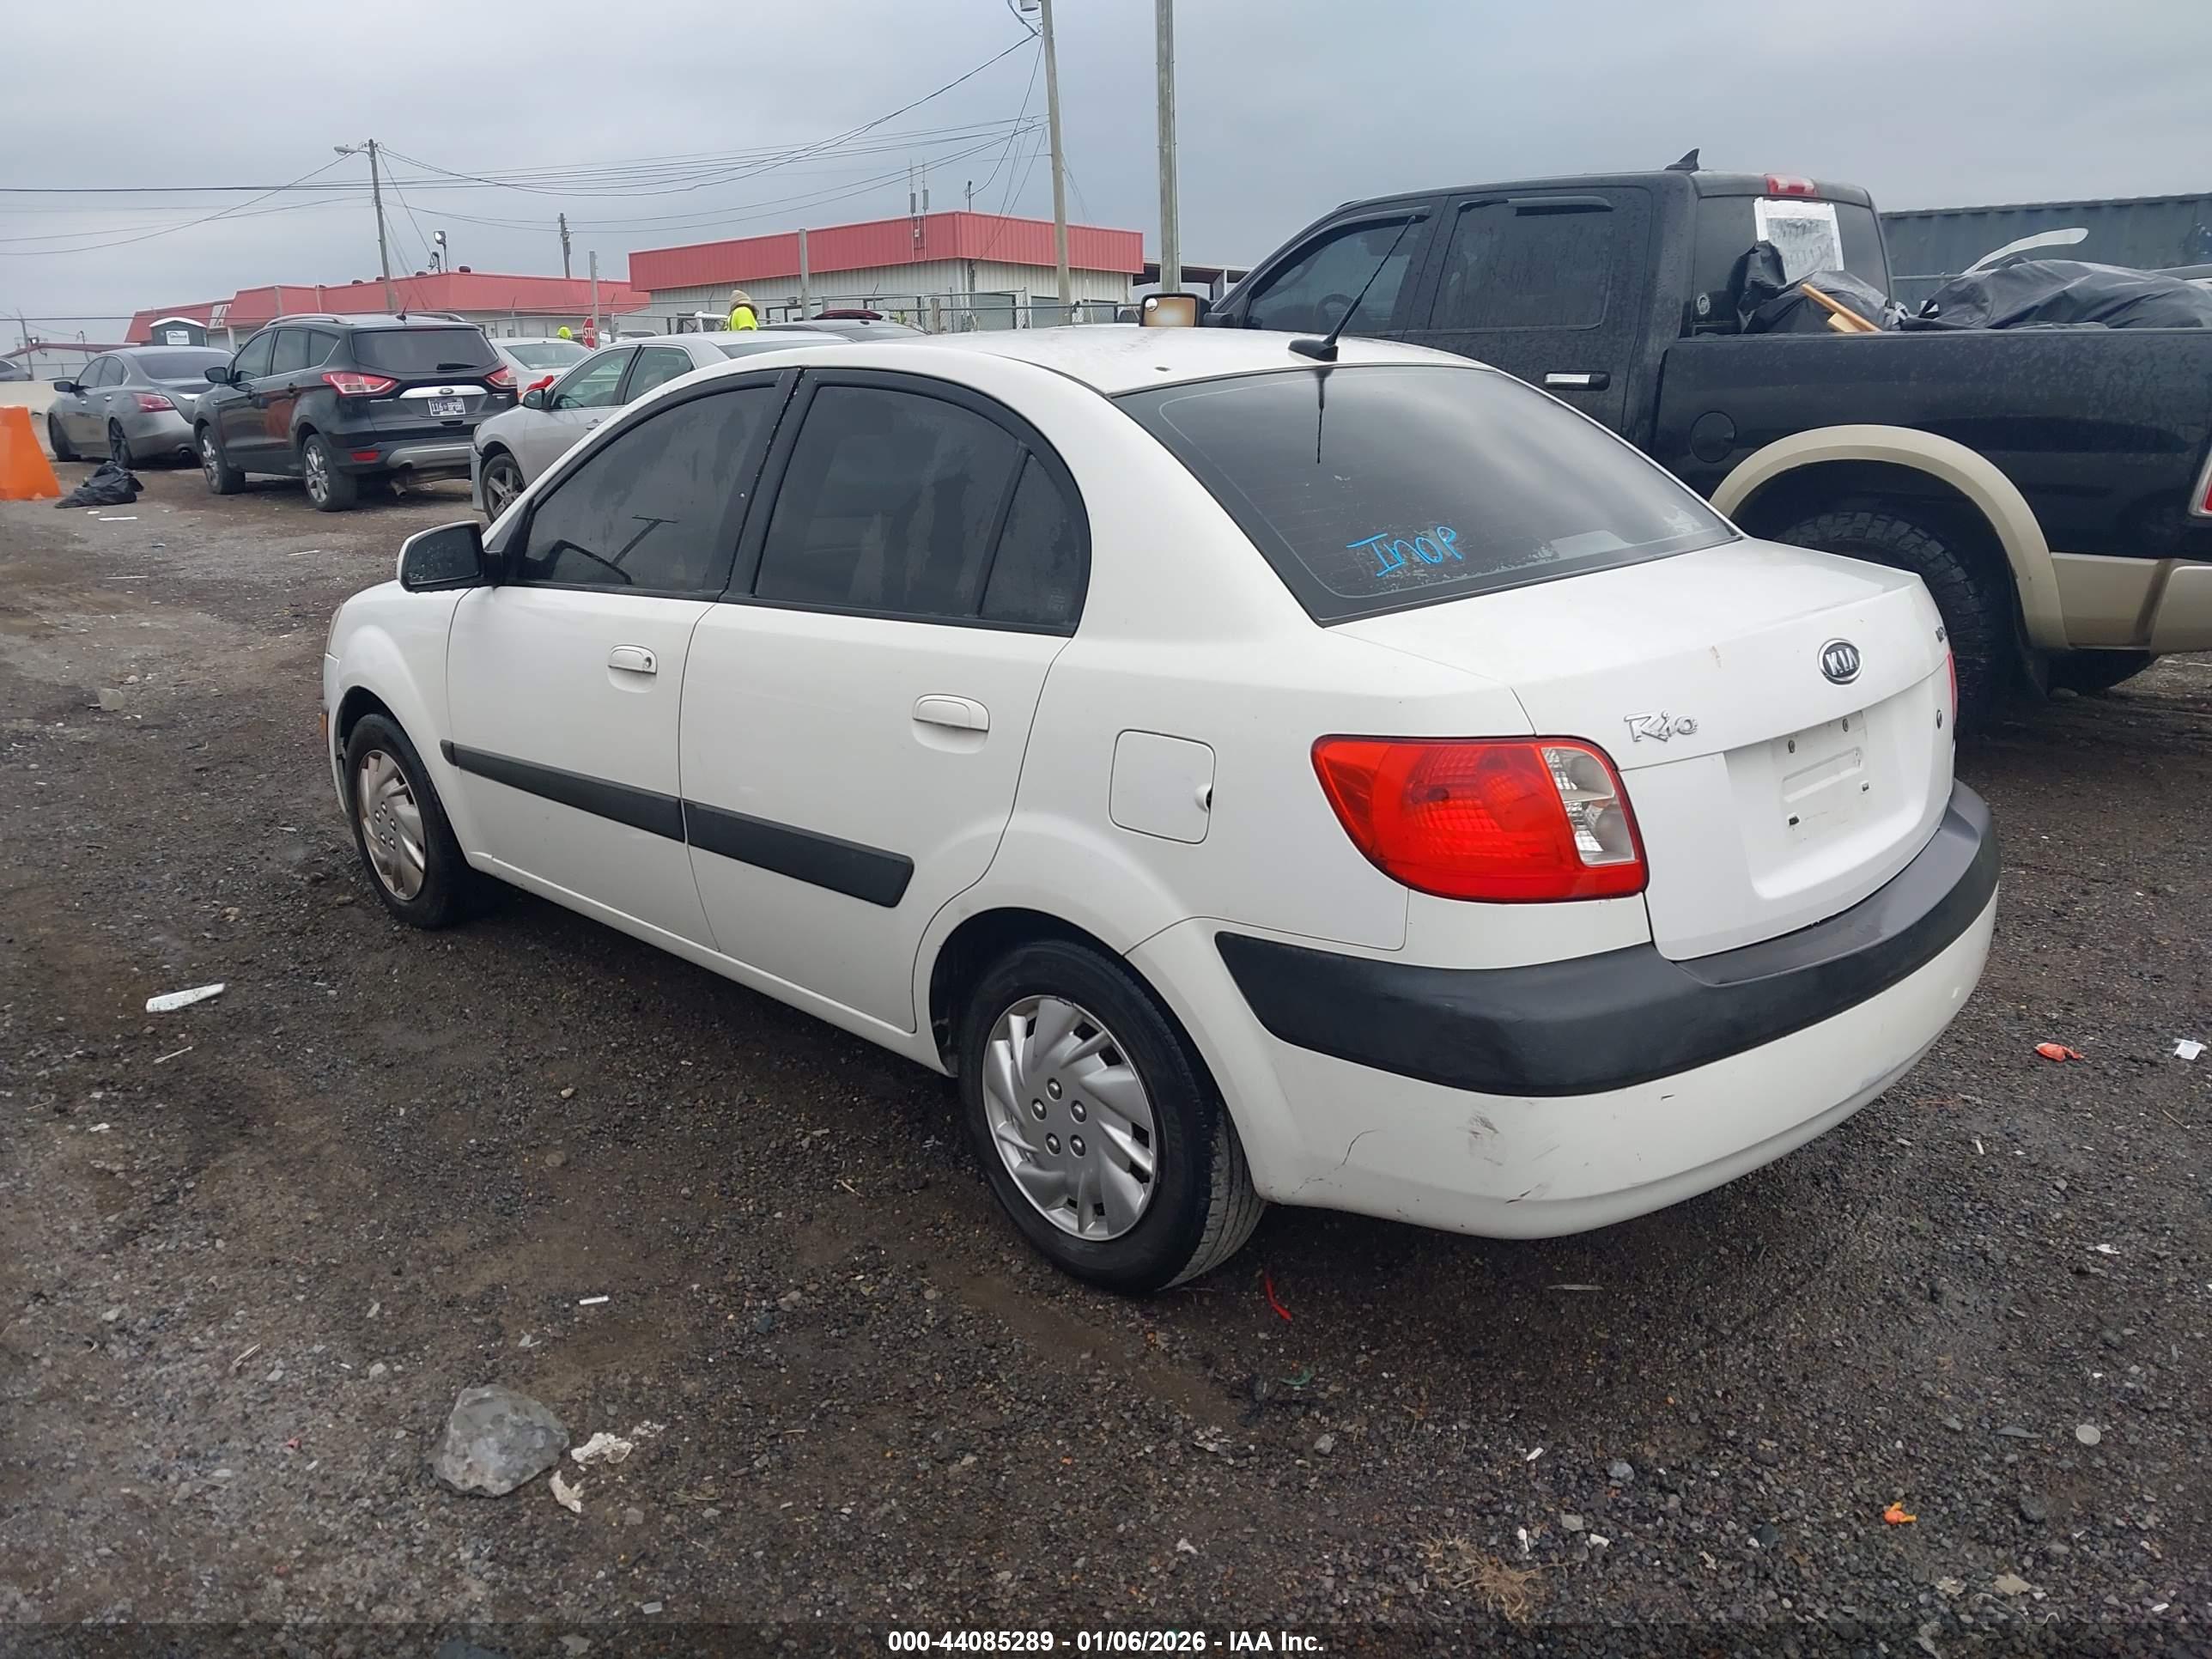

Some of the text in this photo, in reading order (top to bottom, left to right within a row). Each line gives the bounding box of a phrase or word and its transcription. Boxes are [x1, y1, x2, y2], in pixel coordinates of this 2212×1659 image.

[584, 327, 595, 339] STO
[1825, 647, 1858, 676] KIA
[1624, 710, 1698, 743] Rio
